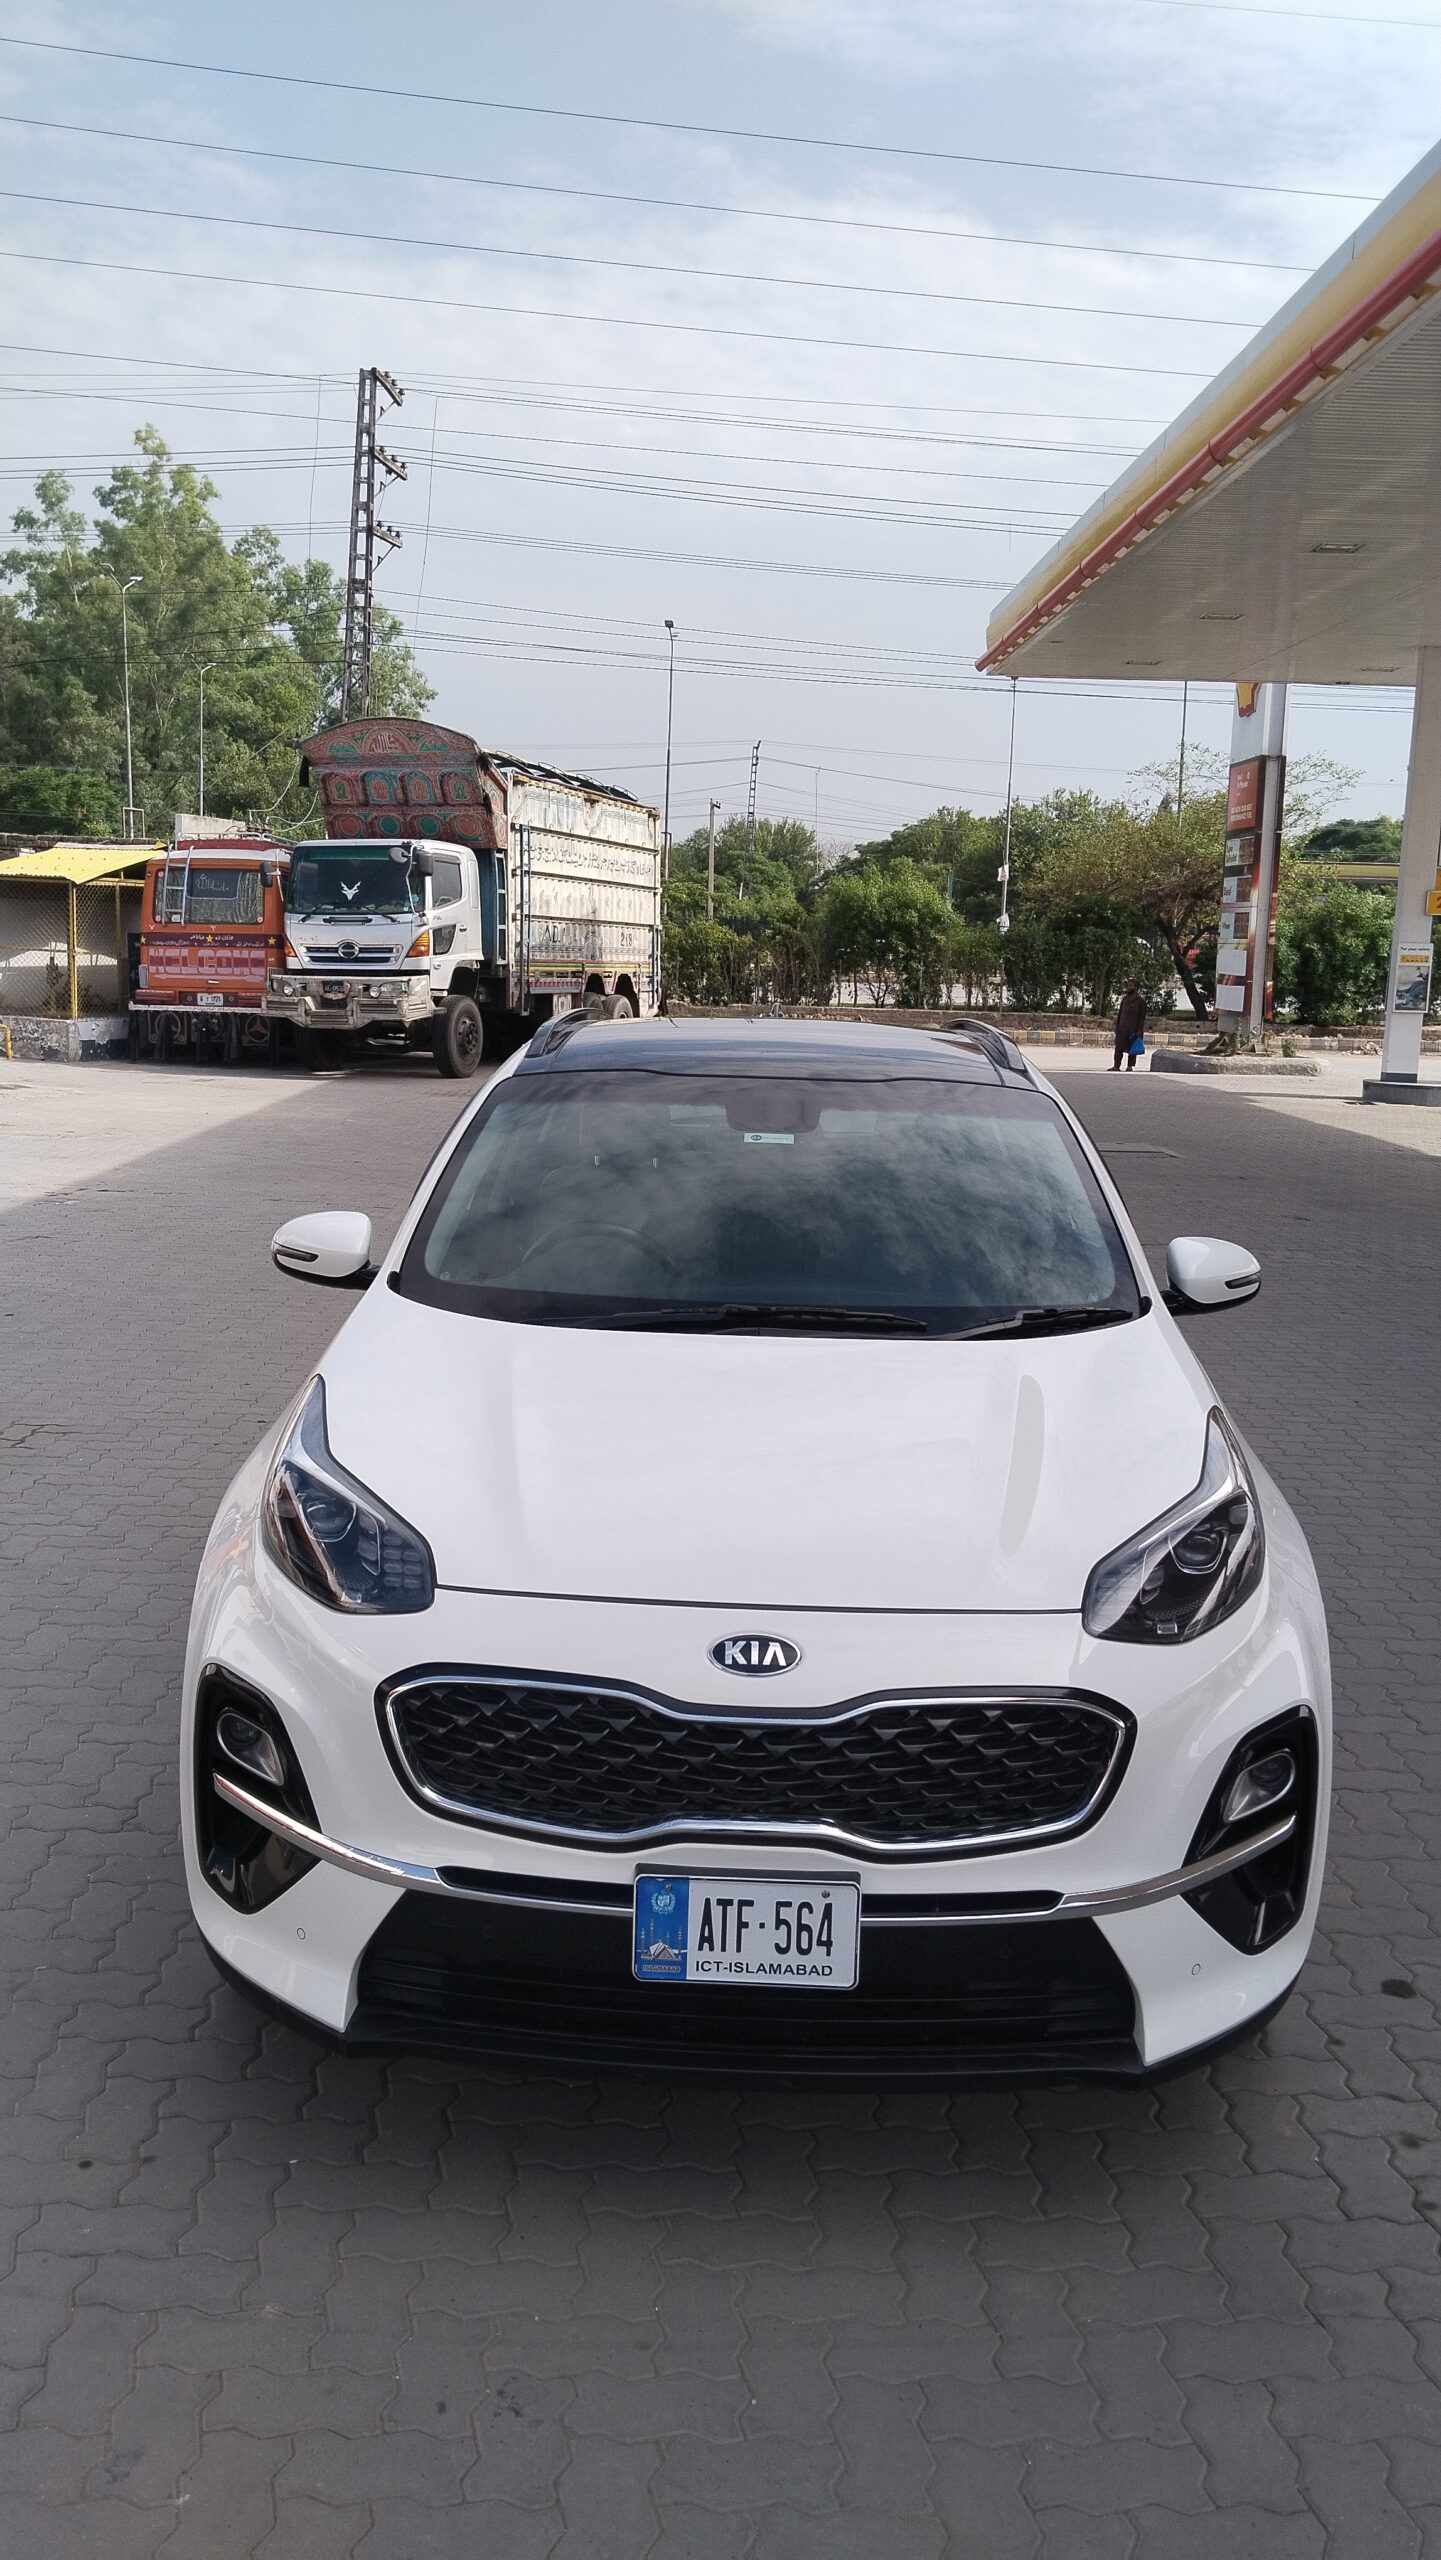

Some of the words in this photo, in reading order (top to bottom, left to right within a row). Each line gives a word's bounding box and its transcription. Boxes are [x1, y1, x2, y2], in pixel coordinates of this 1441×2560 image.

[149, 948, 266, 976] WELCOME
[723, 1641, 788, 1668] KIA
[695, 1960, 833, 1978] ICT-ISLAMABAD
